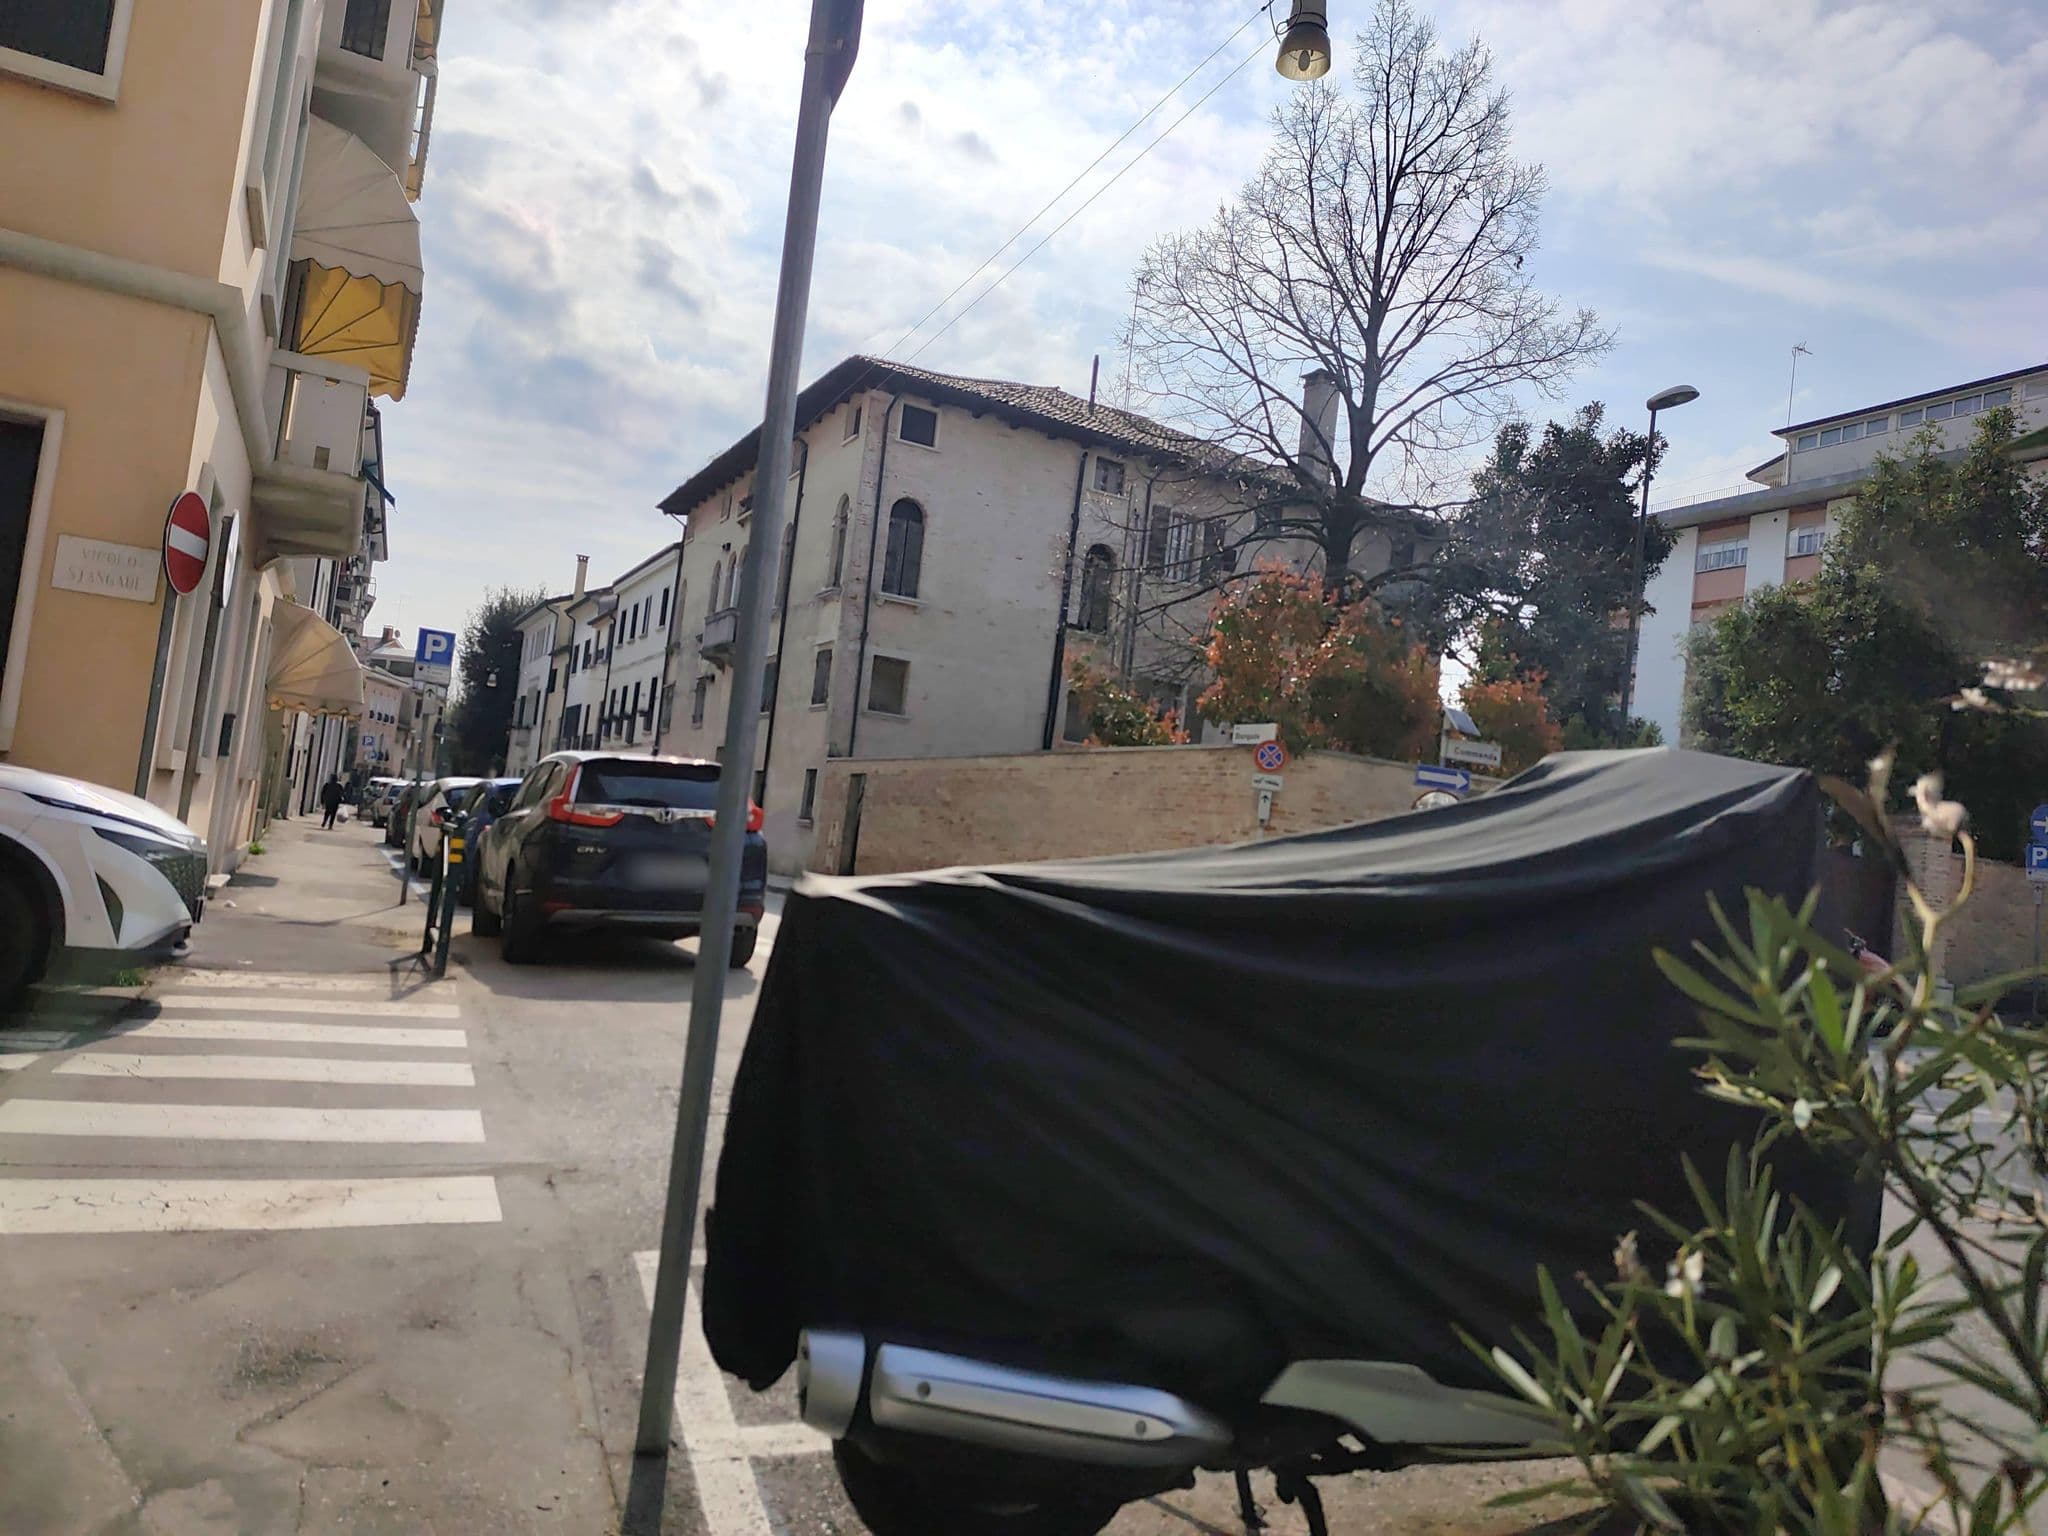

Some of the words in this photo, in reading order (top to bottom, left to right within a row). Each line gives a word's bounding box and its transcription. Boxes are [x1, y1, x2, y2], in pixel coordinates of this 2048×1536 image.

[81, 547, 137, 567] VICOLO
[424, 633, 447, 660] P
[576, 845, 607, 854] CR-V
[2031, 847, 2048, 866] P
